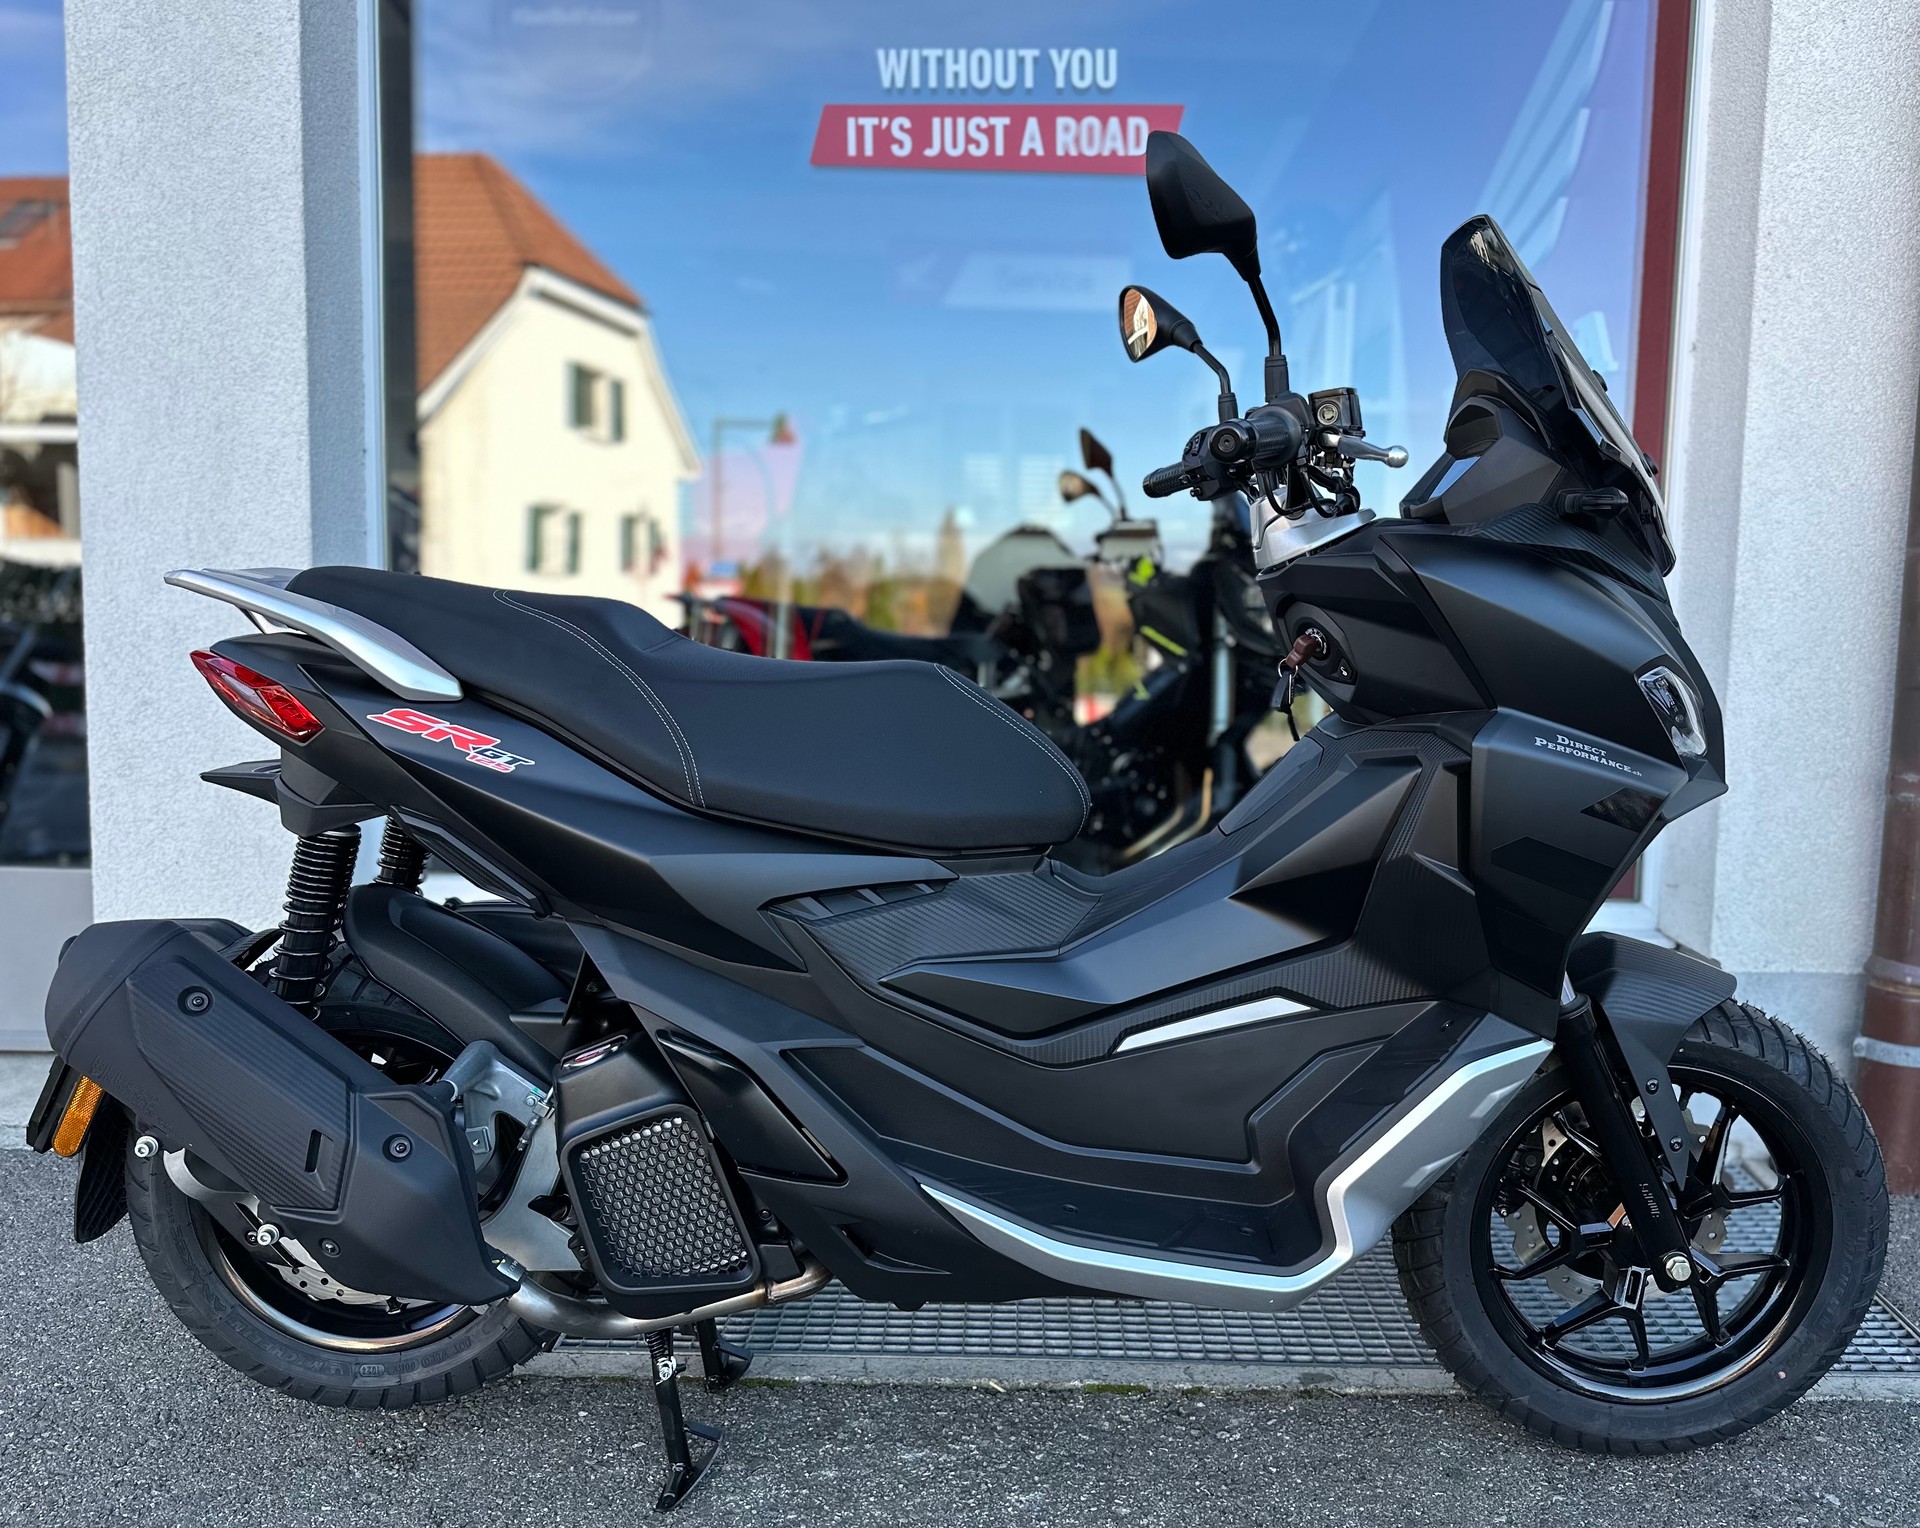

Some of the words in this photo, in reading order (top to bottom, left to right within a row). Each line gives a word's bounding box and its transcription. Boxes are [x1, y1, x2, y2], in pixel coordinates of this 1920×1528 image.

[877, 47, 1039, 90] WITHOUT
[1049, 47, 1119, 90] YOU
[846, 116, 914, 157] IT'S
[923, 116, 1011, 157] JUST
[1020, 116, 1045, 157] A
[1055, 116, 1148, 157] ROAD
[367, 708, 501, 753] SR
[474, 748, 535, 766] GT
[467, 754, 515, 773] 125
[170, 1226, 226, 1311] ANAKEE
[231, 1319, 323, 1370] MICHELIN
